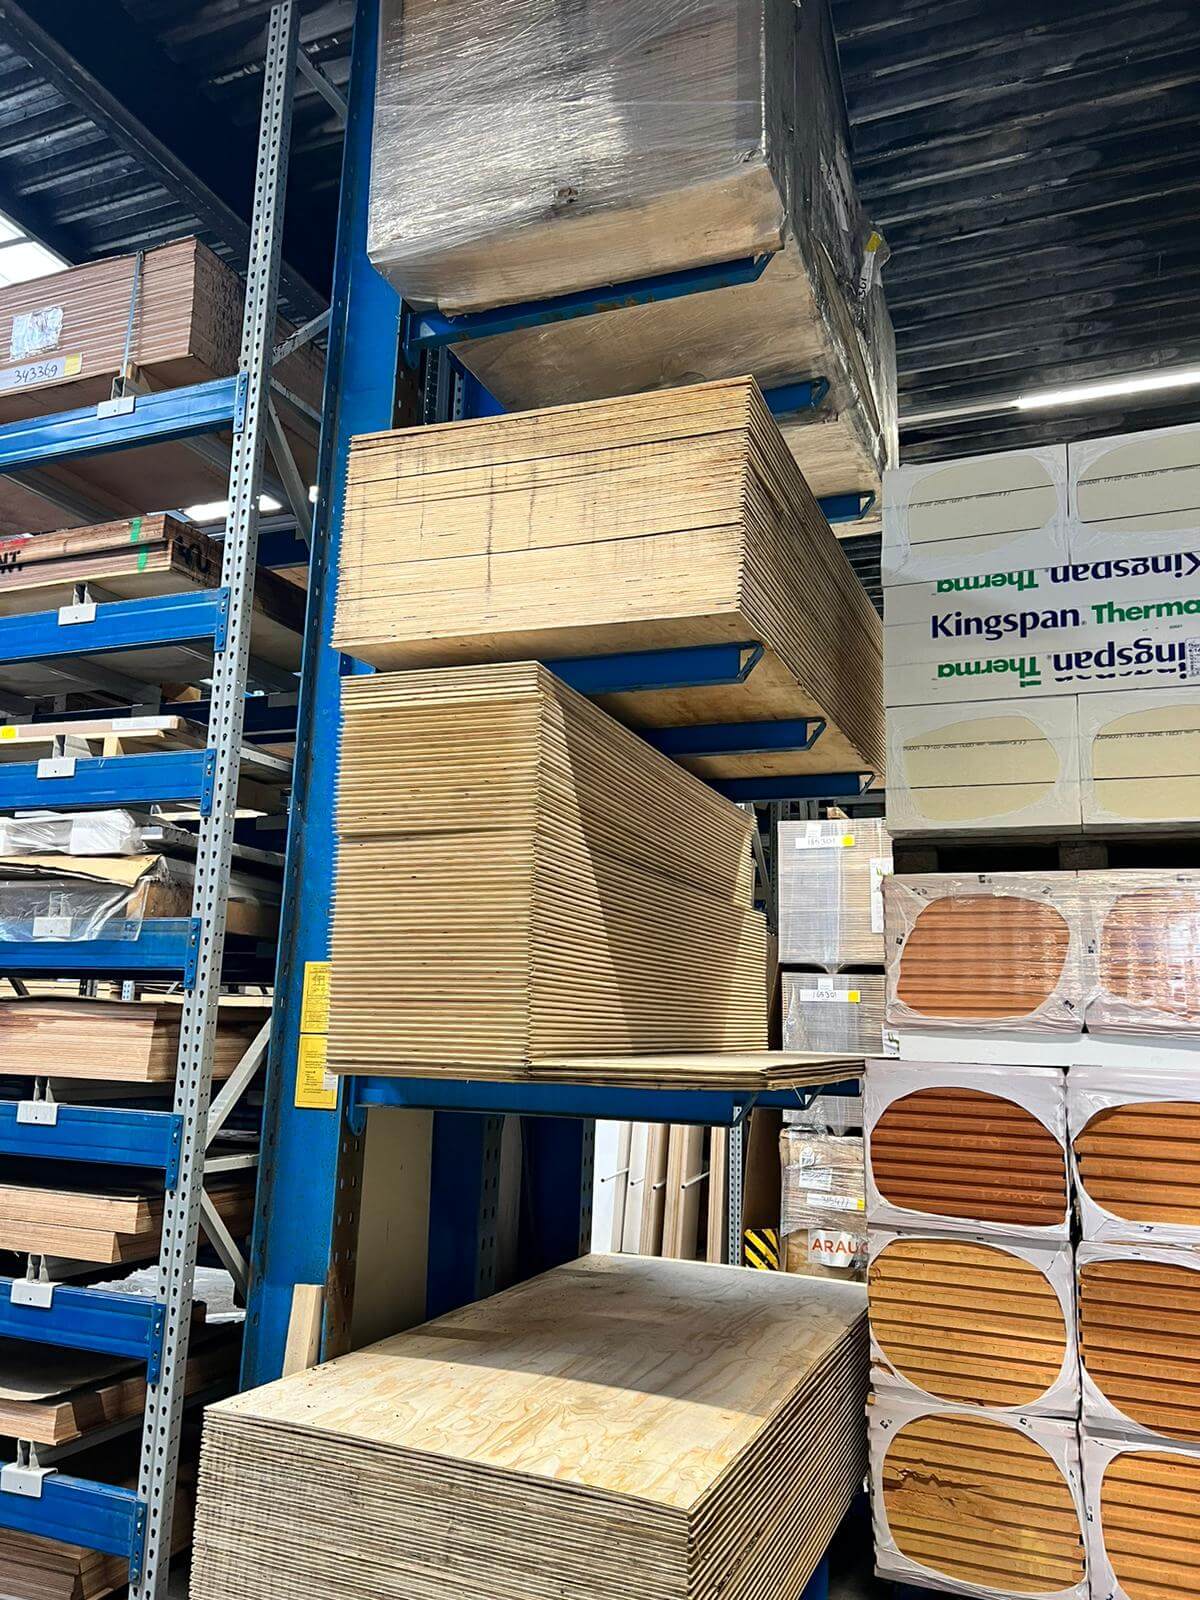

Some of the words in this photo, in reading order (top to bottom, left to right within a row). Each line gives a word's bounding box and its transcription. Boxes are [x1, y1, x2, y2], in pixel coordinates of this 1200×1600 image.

[14, 362, 58, 385] 343369
[937, 569, 1039, 593] Therma
[931, 608, 1080, 641] Kingspan
[1091, 599, 1200, 624] Therma
[937, 656, 1042, 682] Therma
[1053, 638, 1187, 680] ingspan
